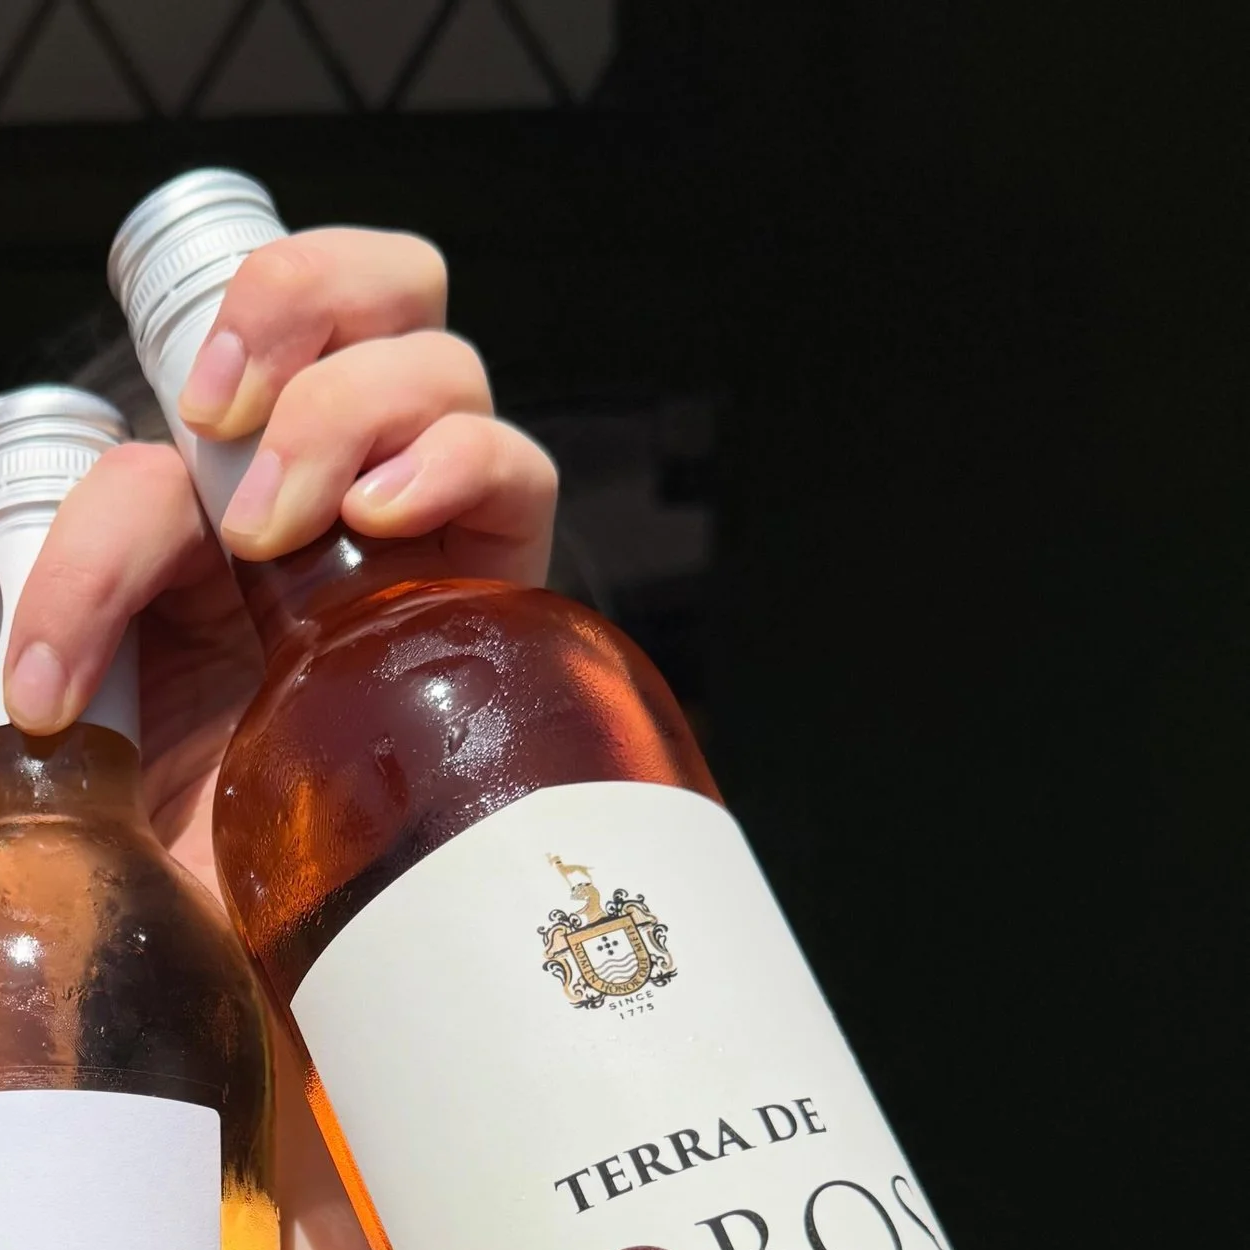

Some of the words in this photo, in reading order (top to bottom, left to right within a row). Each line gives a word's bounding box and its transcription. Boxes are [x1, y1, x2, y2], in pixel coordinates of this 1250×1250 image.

[608, 990, 655, 1011] SINCE
[618, 1003, 655, 1020] 1775
[554, 1117, 758, 1215] TERRA
[752, 1097, 827, 1144] DE
